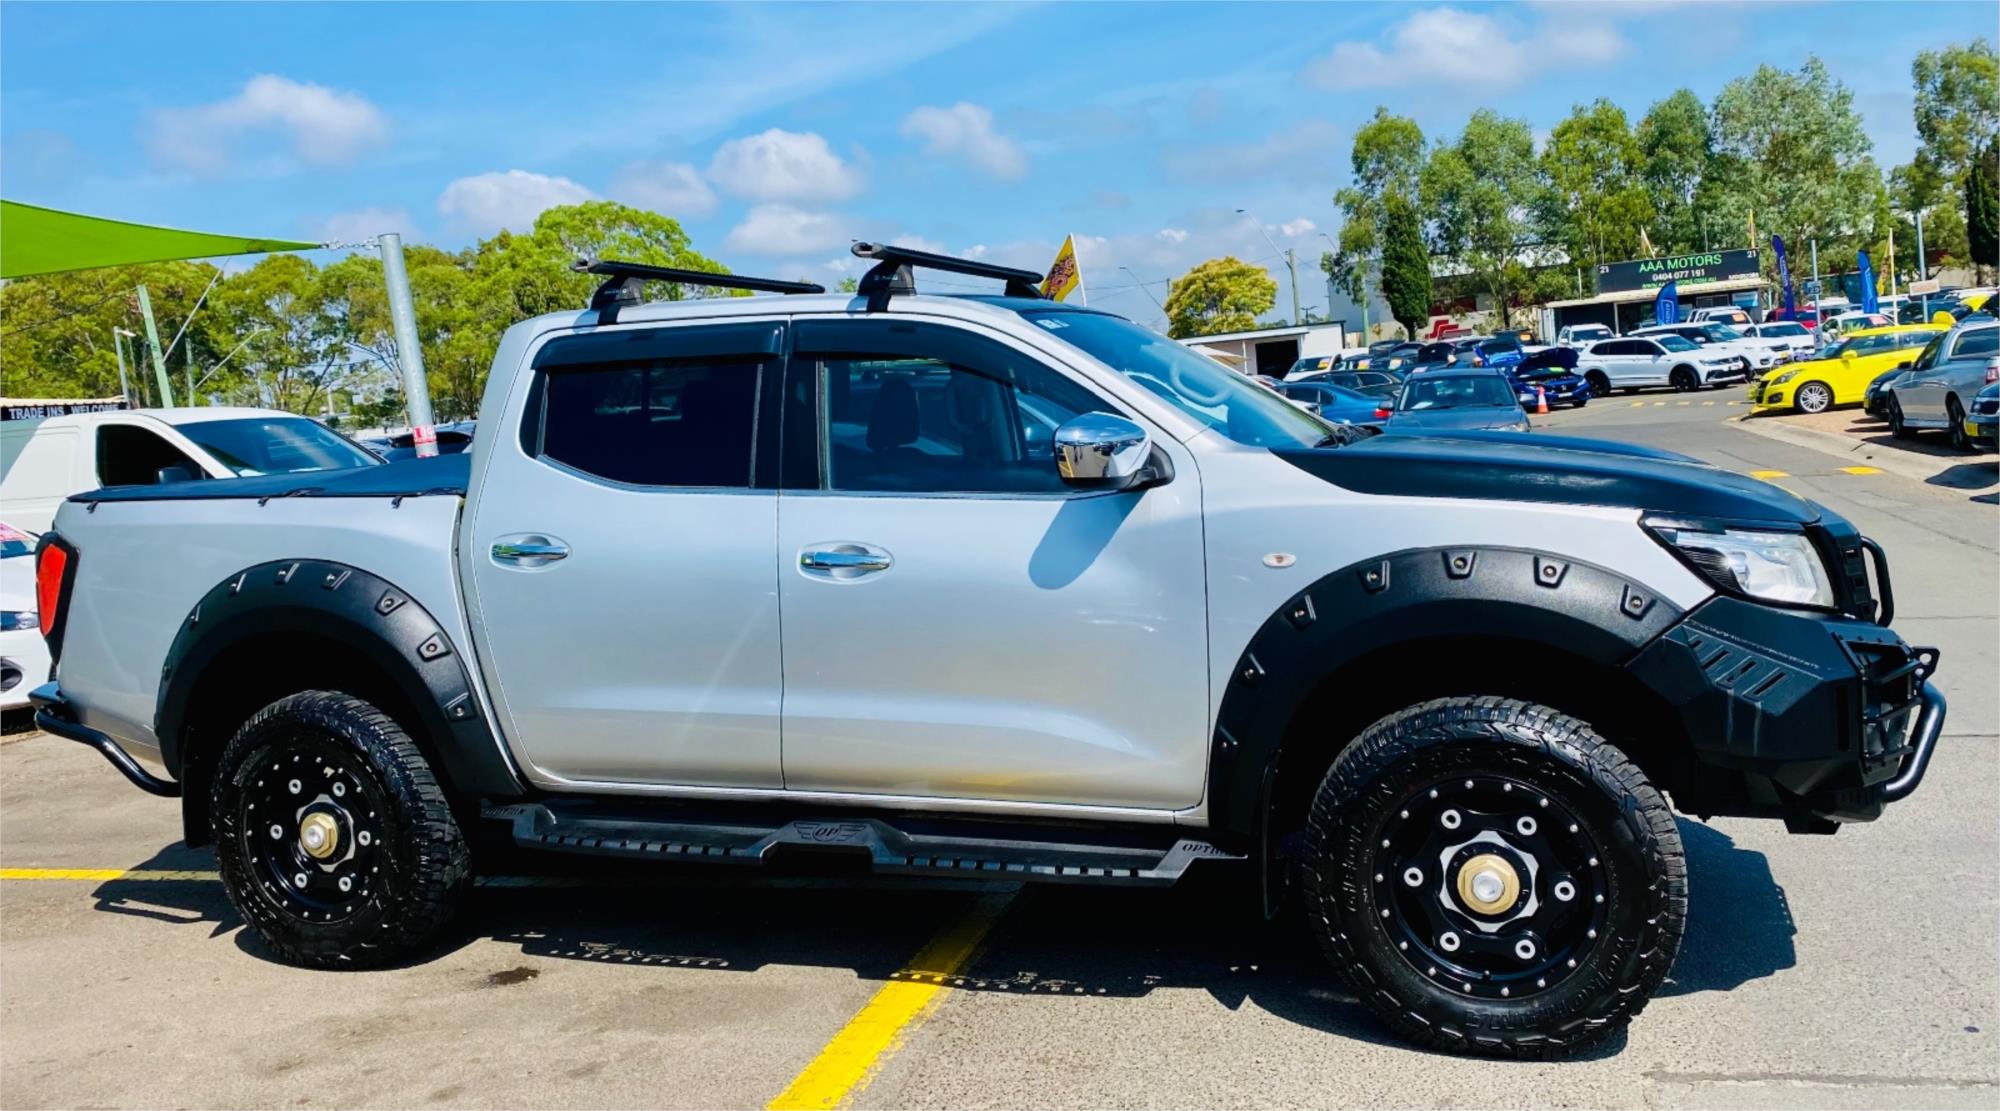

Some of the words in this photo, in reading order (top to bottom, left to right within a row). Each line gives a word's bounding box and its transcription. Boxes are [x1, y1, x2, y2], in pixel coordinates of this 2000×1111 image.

[1746, 249, 1757, 259] 21
[1600, 265, 1610, 274] 21
[1639, 260, 1664, 273] AAA
[1667, 254, 1722, 270] MOTORS
[1652, 272, 1673, 282] 0404
[1673, 269, 1689, 280] 077
[1690, 268, 1705, 278] 191
[9, 408, 45, 420] TRADE
[46, 406, 65, 417] INS
